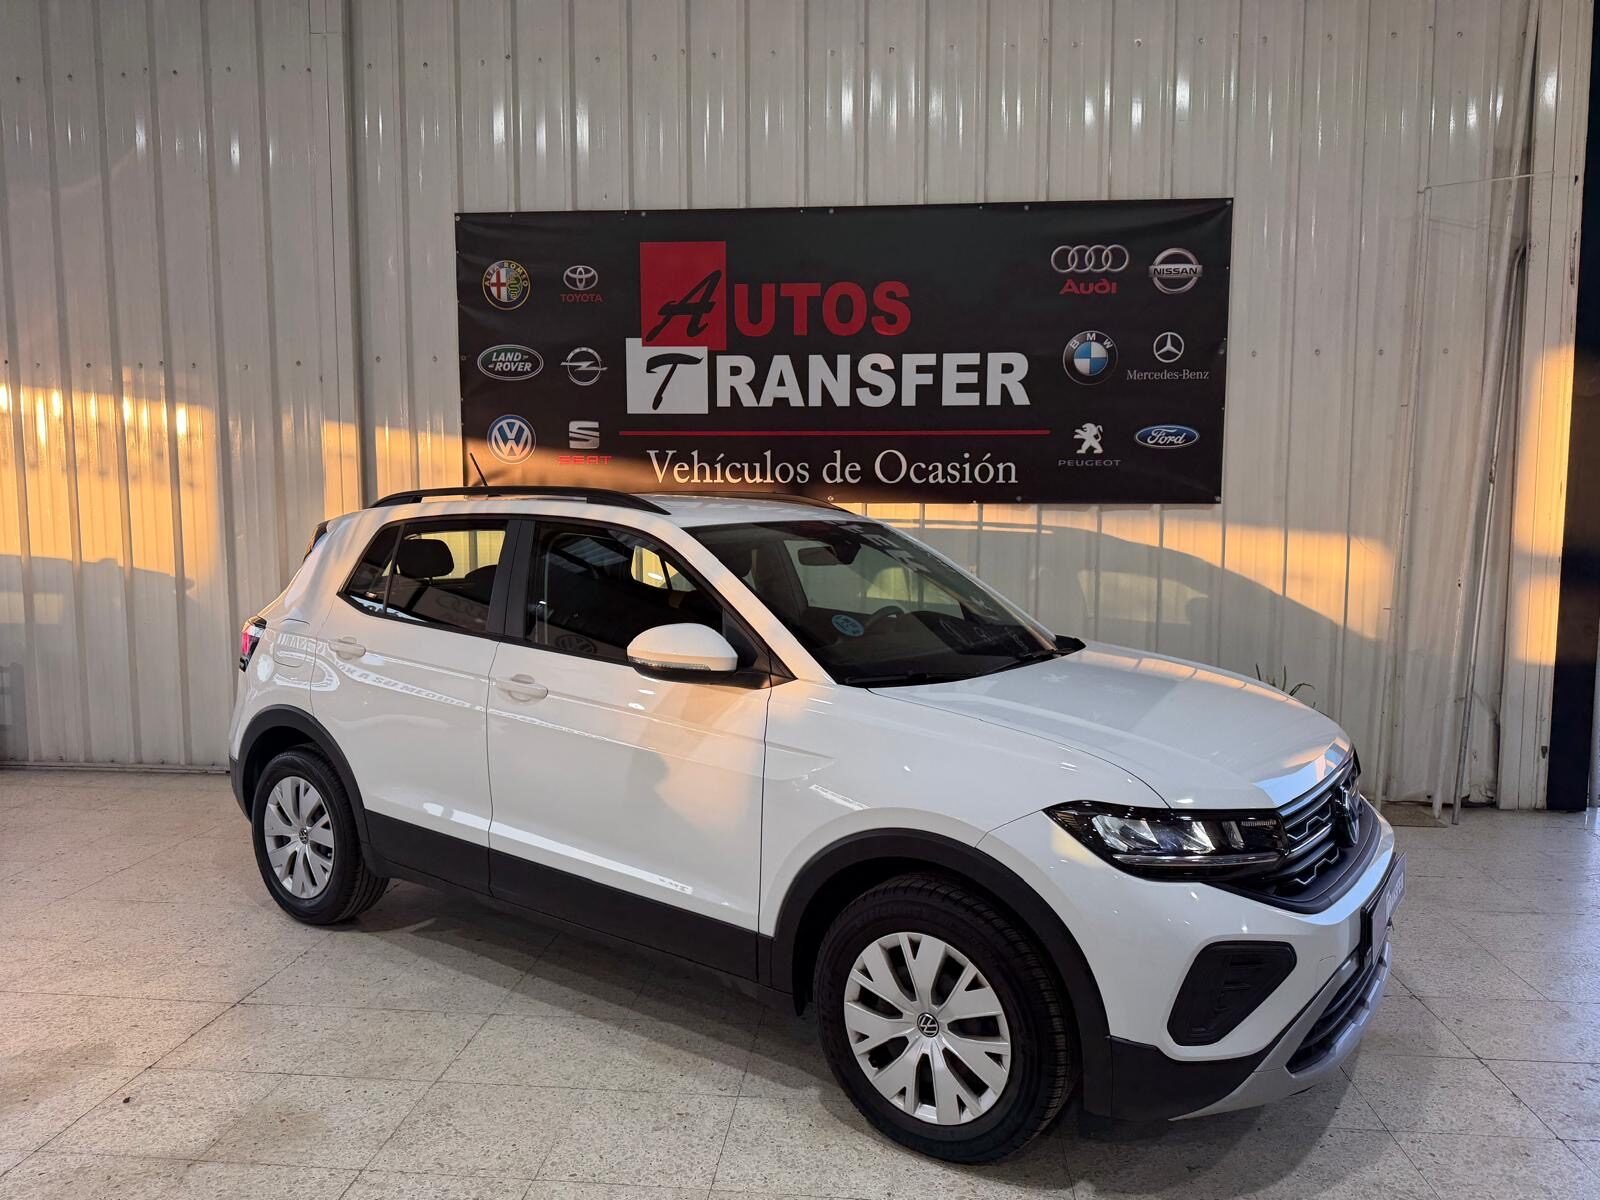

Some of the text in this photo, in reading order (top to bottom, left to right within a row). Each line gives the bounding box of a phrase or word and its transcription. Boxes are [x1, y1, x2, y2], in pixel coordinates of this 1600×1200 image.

[1153, 266, 1198, 276] NISSAN
[1059, 277, 1118, 295] Audi
[560, 293, 603, 303] TOYOTA
[646, 270, 911, 343] AUTOS
[1069, 332, 1113, 349] BMW
[492, 352, 522, 362] LAND
[495, 362, 532, 372] ROVER
[1126, 369, 1209, 381] Mercedes-Benz
[646, 352, 1031, 411] TRANSFER
[1147, 428, 1187, 445] Ford
[558, 455, 612, 465] SEAT
[1058, 459, 1121, 467] PEUGEOT
[647, 449, 1018, 484] Vehículos de Ocasión
